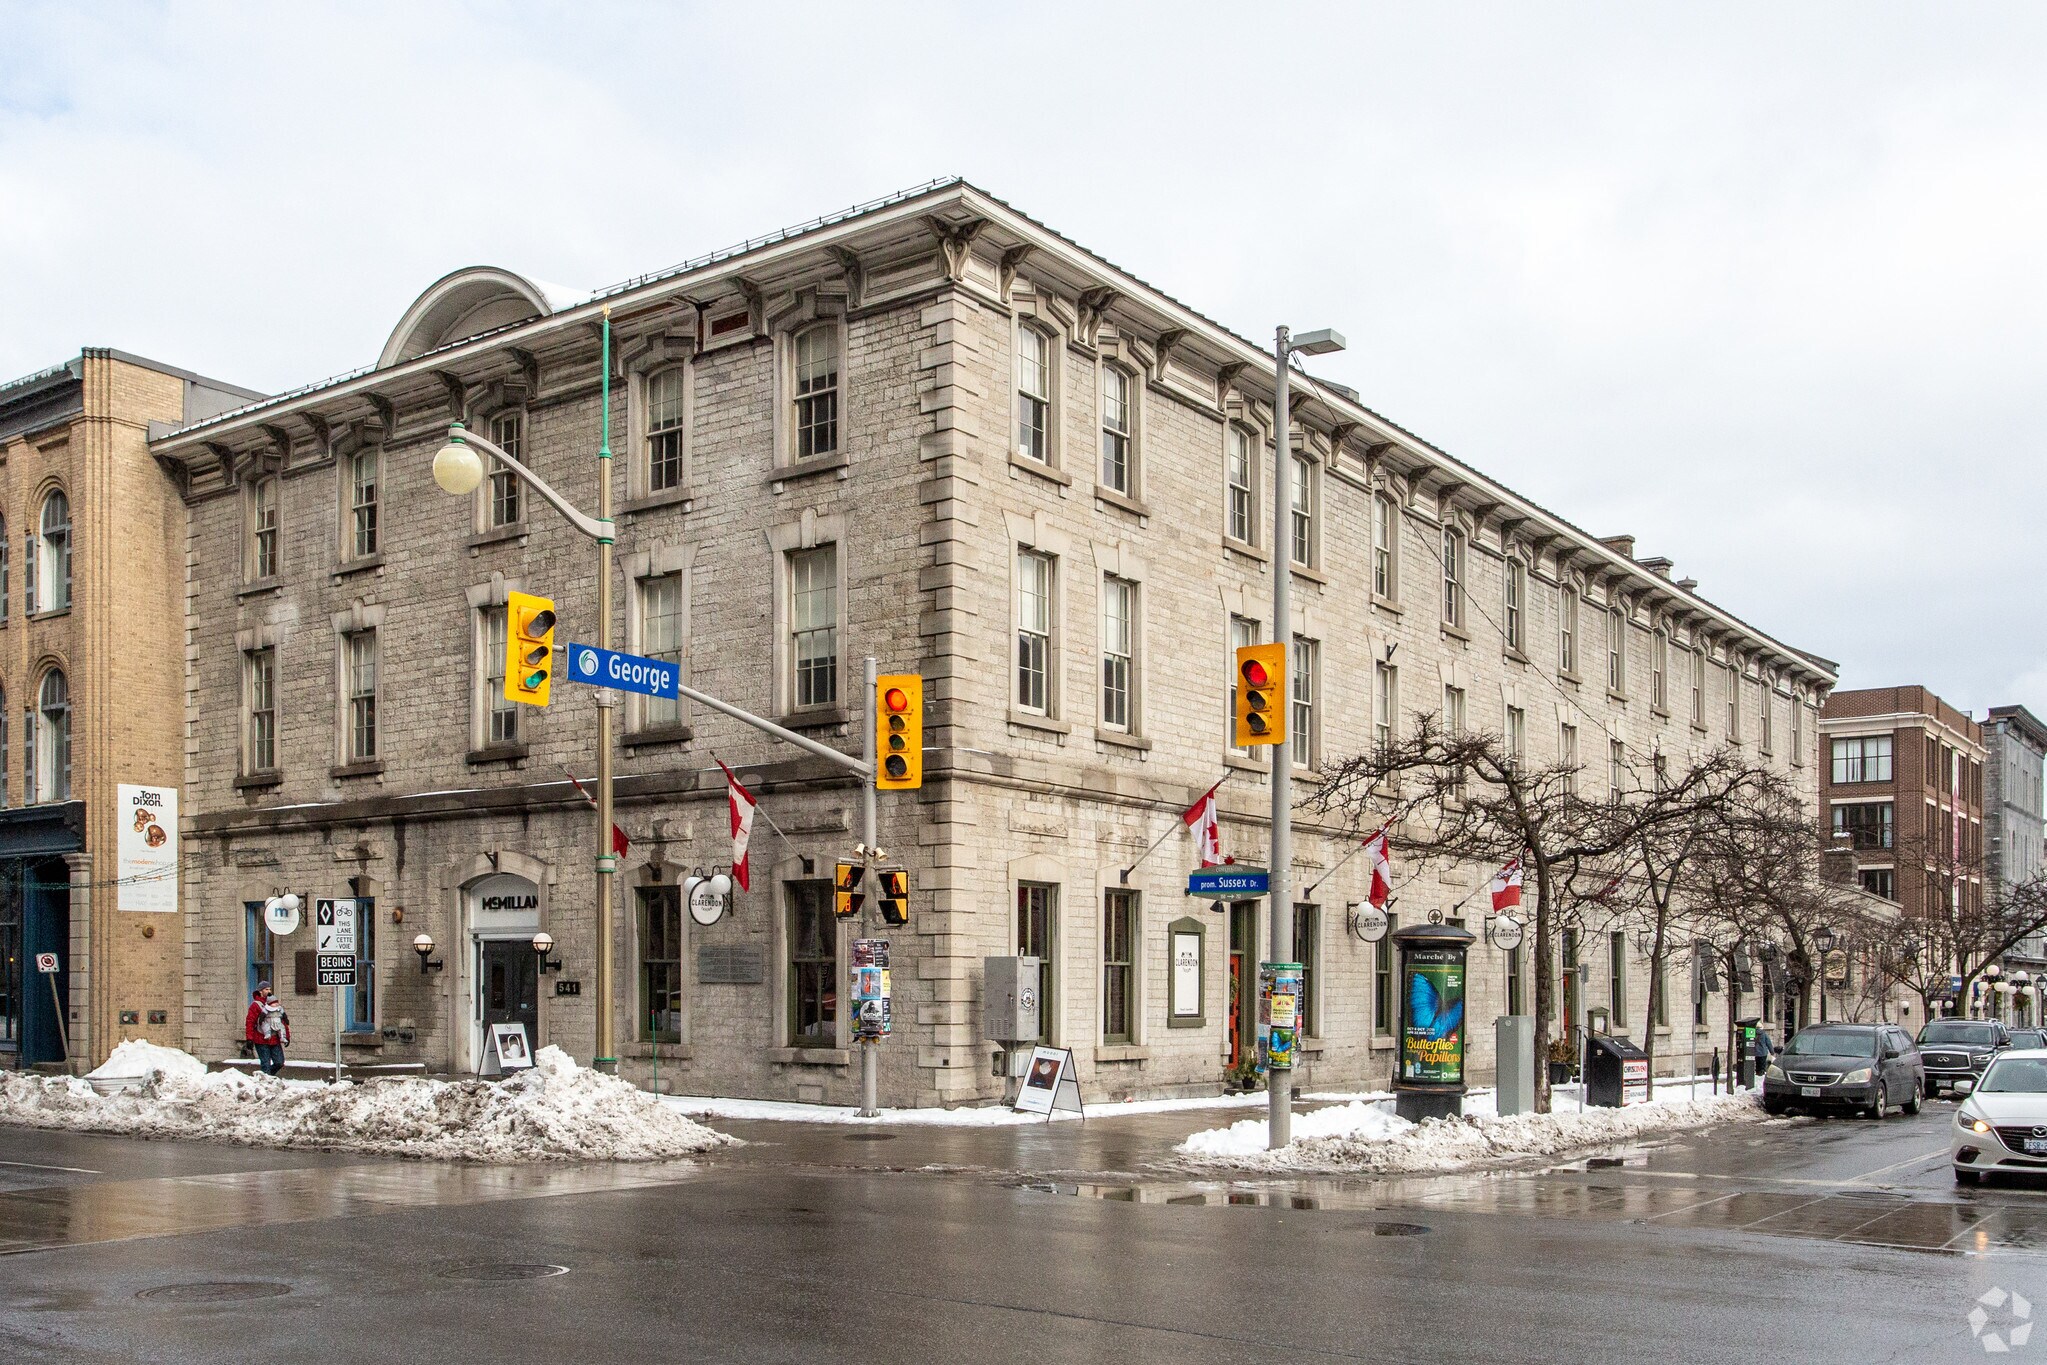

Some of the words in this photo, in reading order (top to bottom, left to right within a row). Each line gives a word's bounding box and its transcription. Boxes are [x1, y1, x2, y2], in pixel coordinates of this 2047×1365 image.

[609, 655, 670, 694] George
[1200, 881, 1217, 890] prom.
[1218, 877, 1247, 888] Sussex
[1249, 880, 1259, 888] Dr.
[691, 899, 723, 907] CLARENDON
[1357, 920, 1387, 928] CLARENDON
[320, 956, 352, 967] BEGINS
[1175, 958, 1199, 967] CLARENDON
[322, 970, 351, 983] DÉBUT
[558, 983, 577, 993] 541
[1406, 1037, 1454, 1054] Butterflies
[1418, 1049, 1461, 1066] Papillons
